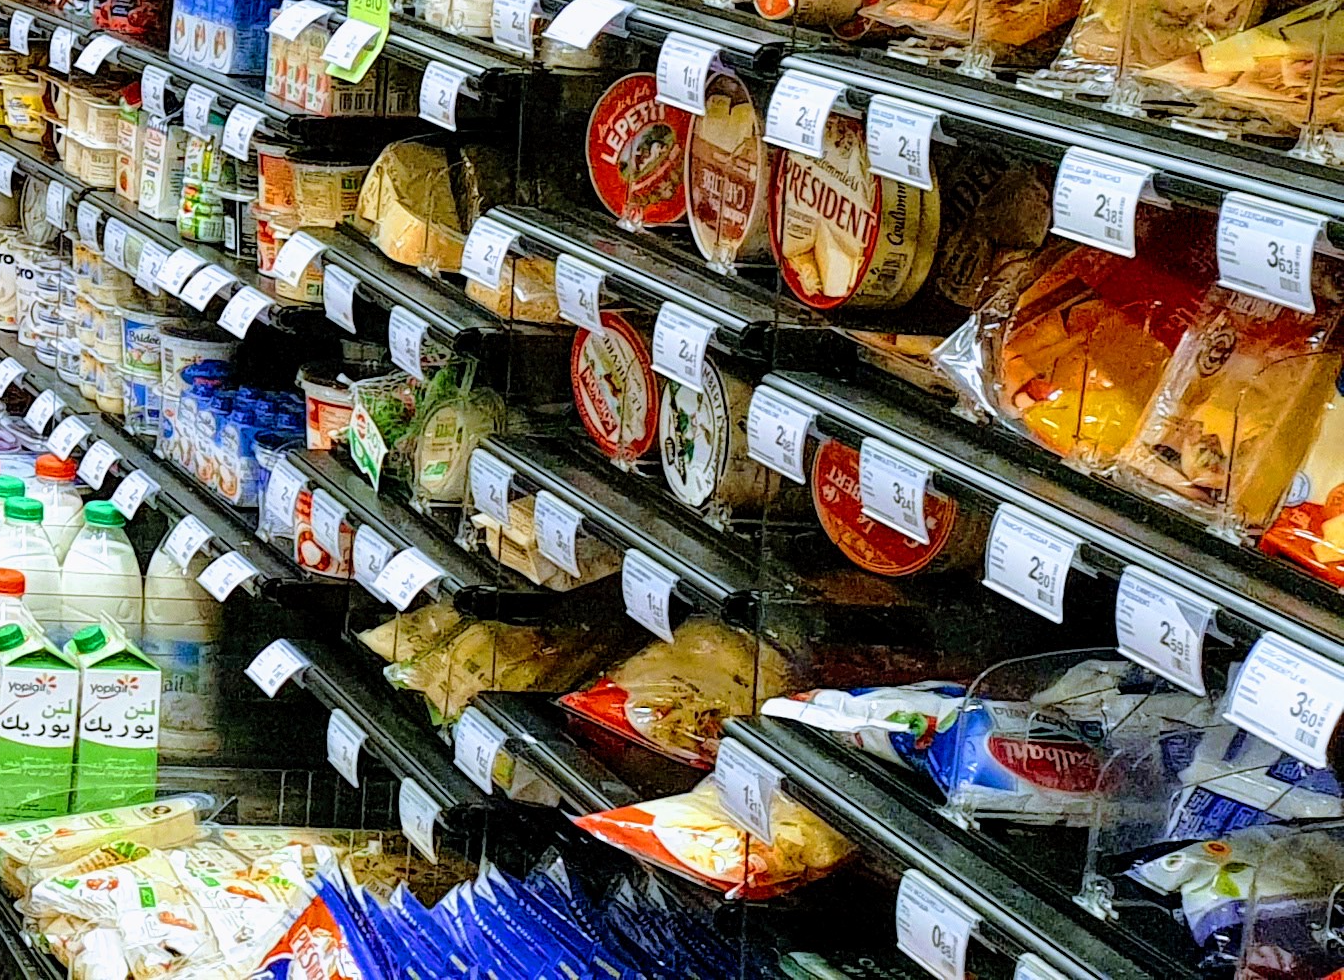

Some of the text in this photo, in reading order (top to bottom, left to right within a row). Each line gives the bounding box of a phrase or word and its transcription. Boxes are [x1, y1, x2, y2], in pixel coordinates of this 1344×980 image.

[785, 154, 877, 248] PRÉSIDENT
[9, 680, 47, 694] yoplait
[91, 681, 130, 695] yoplait
